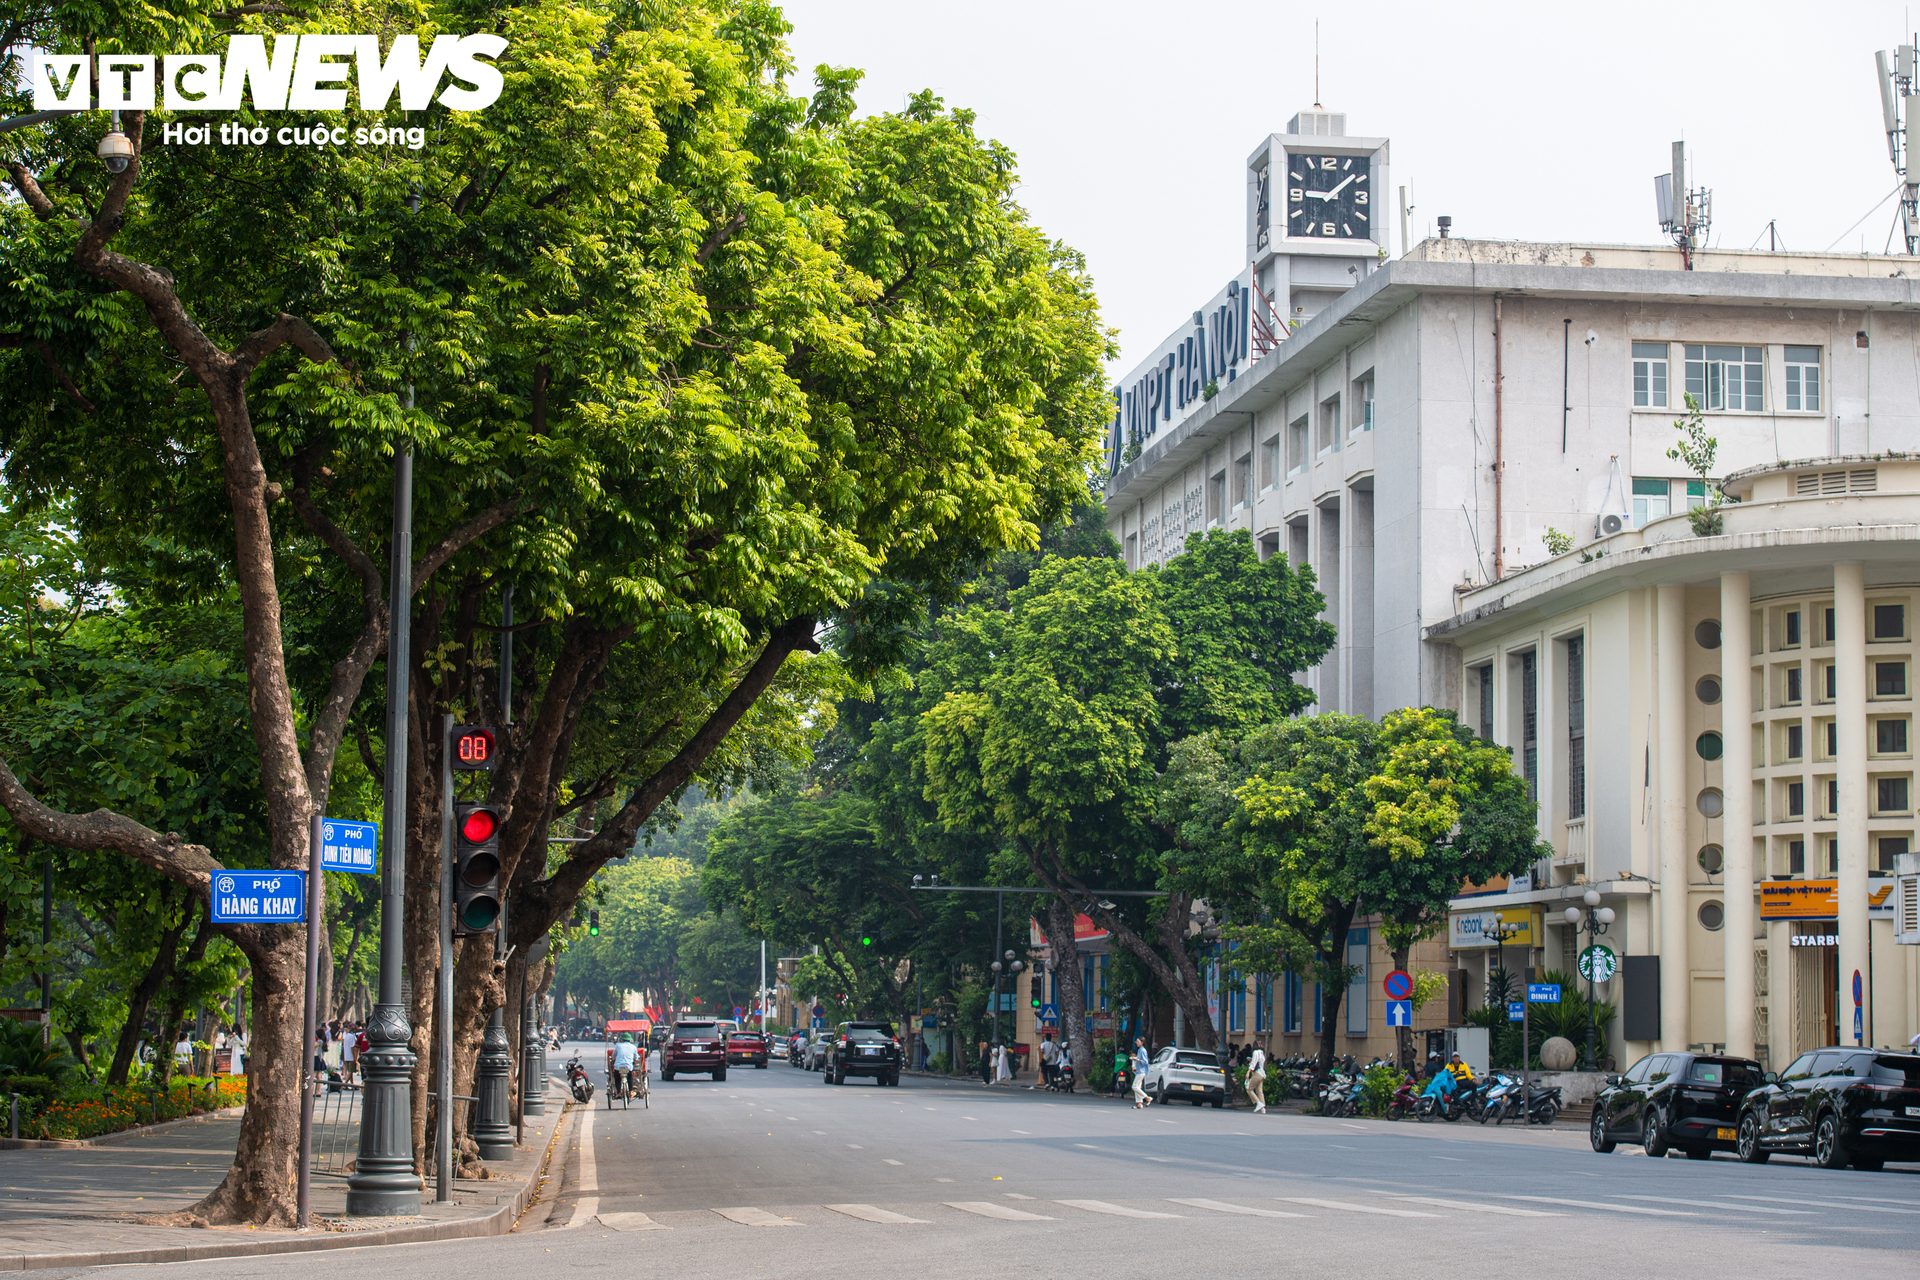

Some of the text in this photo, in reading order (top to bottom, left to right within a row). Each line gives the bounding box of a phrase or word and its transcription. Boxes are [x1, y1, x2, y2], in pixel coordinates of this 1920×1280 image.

[1320, 157, 1337, 170] 12
[1290, 188, 1303, 202] 9
[1355, 191, 1368, 204] 3
[1322, 222, 1336, 236] 6
[1123, 280, 1249, 443] VNPT HÀ NỘI
[459, 736, 487, 760] 08
[344, 826, 364, 839] PHỐ
[221, 894, 297, 915] HÀNG KHAY
[1791, 935, 1839, 947] STARB
